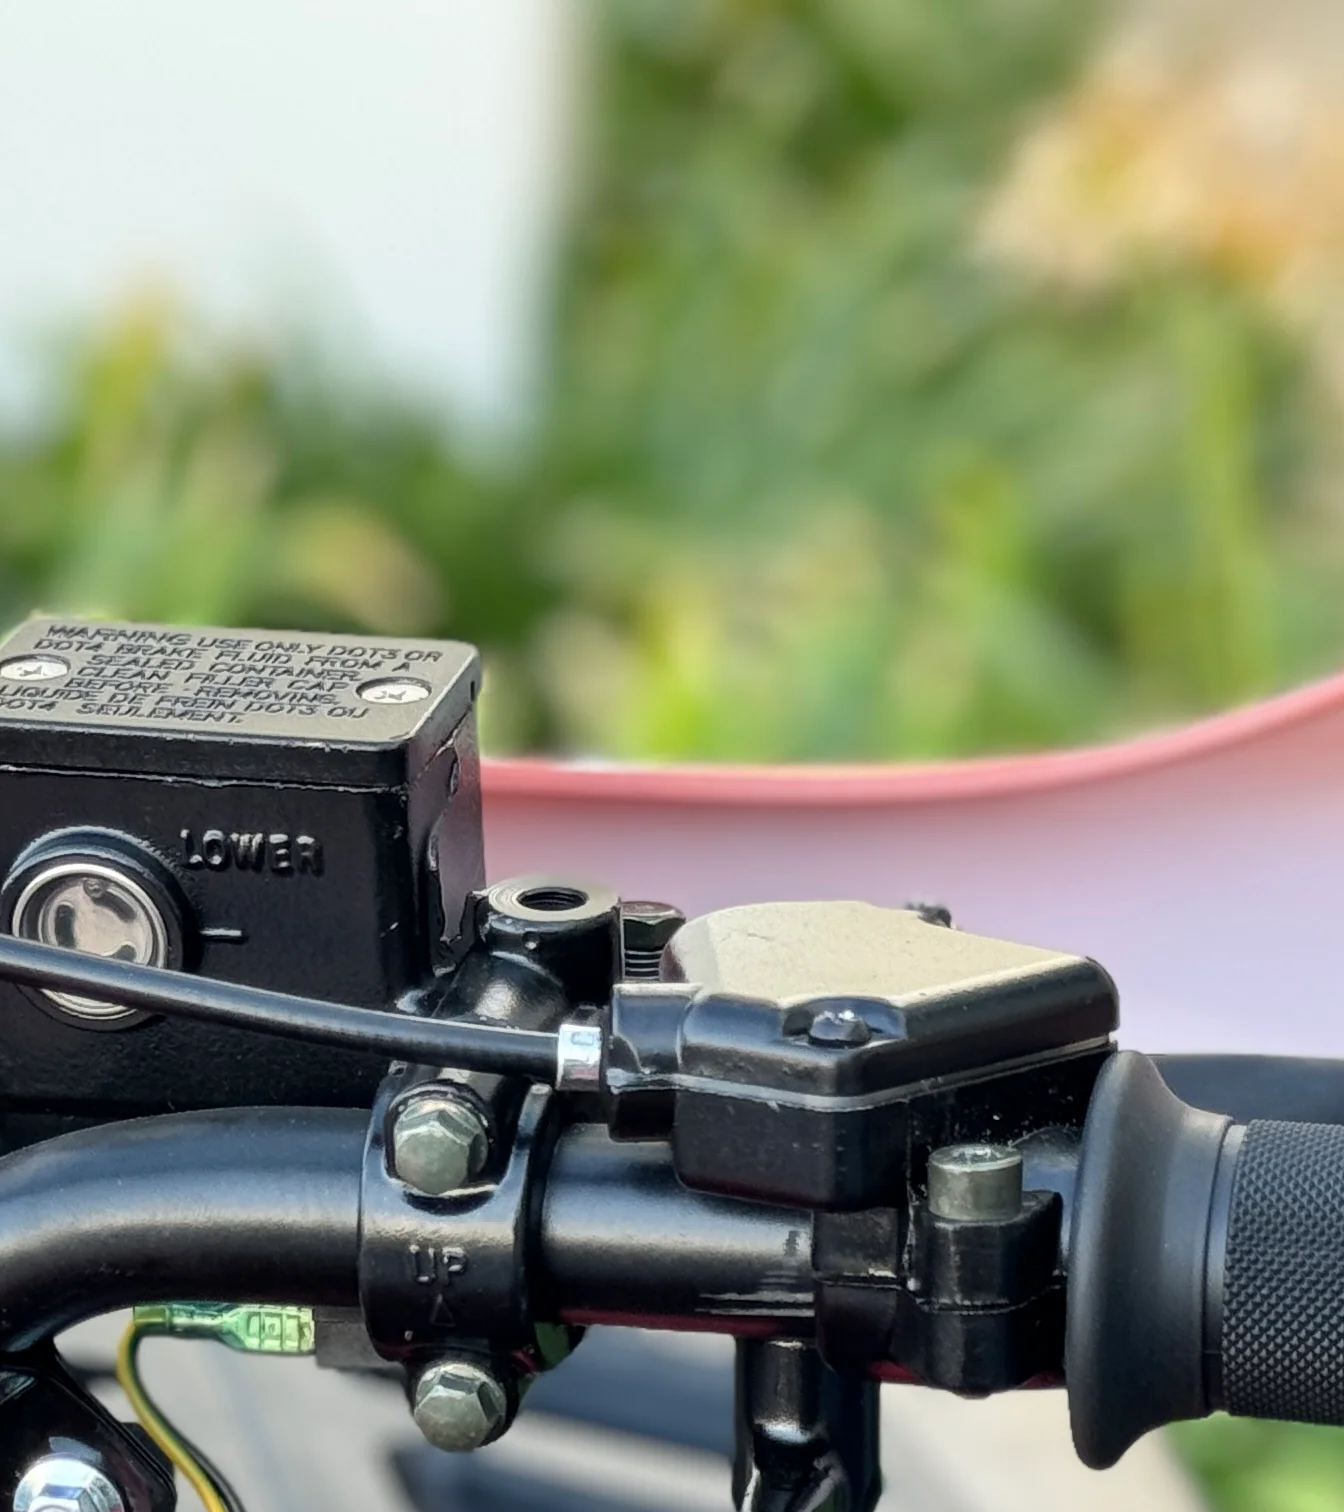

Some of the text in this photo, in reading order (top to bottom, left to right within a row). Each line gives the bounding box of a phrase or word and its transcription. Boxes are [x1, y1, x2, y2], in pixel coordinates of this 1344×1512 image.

[33, 638, 410, 672] DOT4 BRAKE FLUID FROM A
[46, 625, 193, 646] WARNING
[197, 636, 253, 651] USE
[255, 640, 325, 655] ONLY
[404, 650, 443, 663] OR
[86, 654, 196, 671] SEALED
[64, 678, 174, 694] BEFORE
[77, 666, 171, 681] CLEAN
[287, 679, 351, 692] CAP
[107, 692, 152, 706] DE
[155, 695, 237, 710] FREIN
[179, 828, 324, 878] LOWER
[408, 1243, 468, 1288] UP
